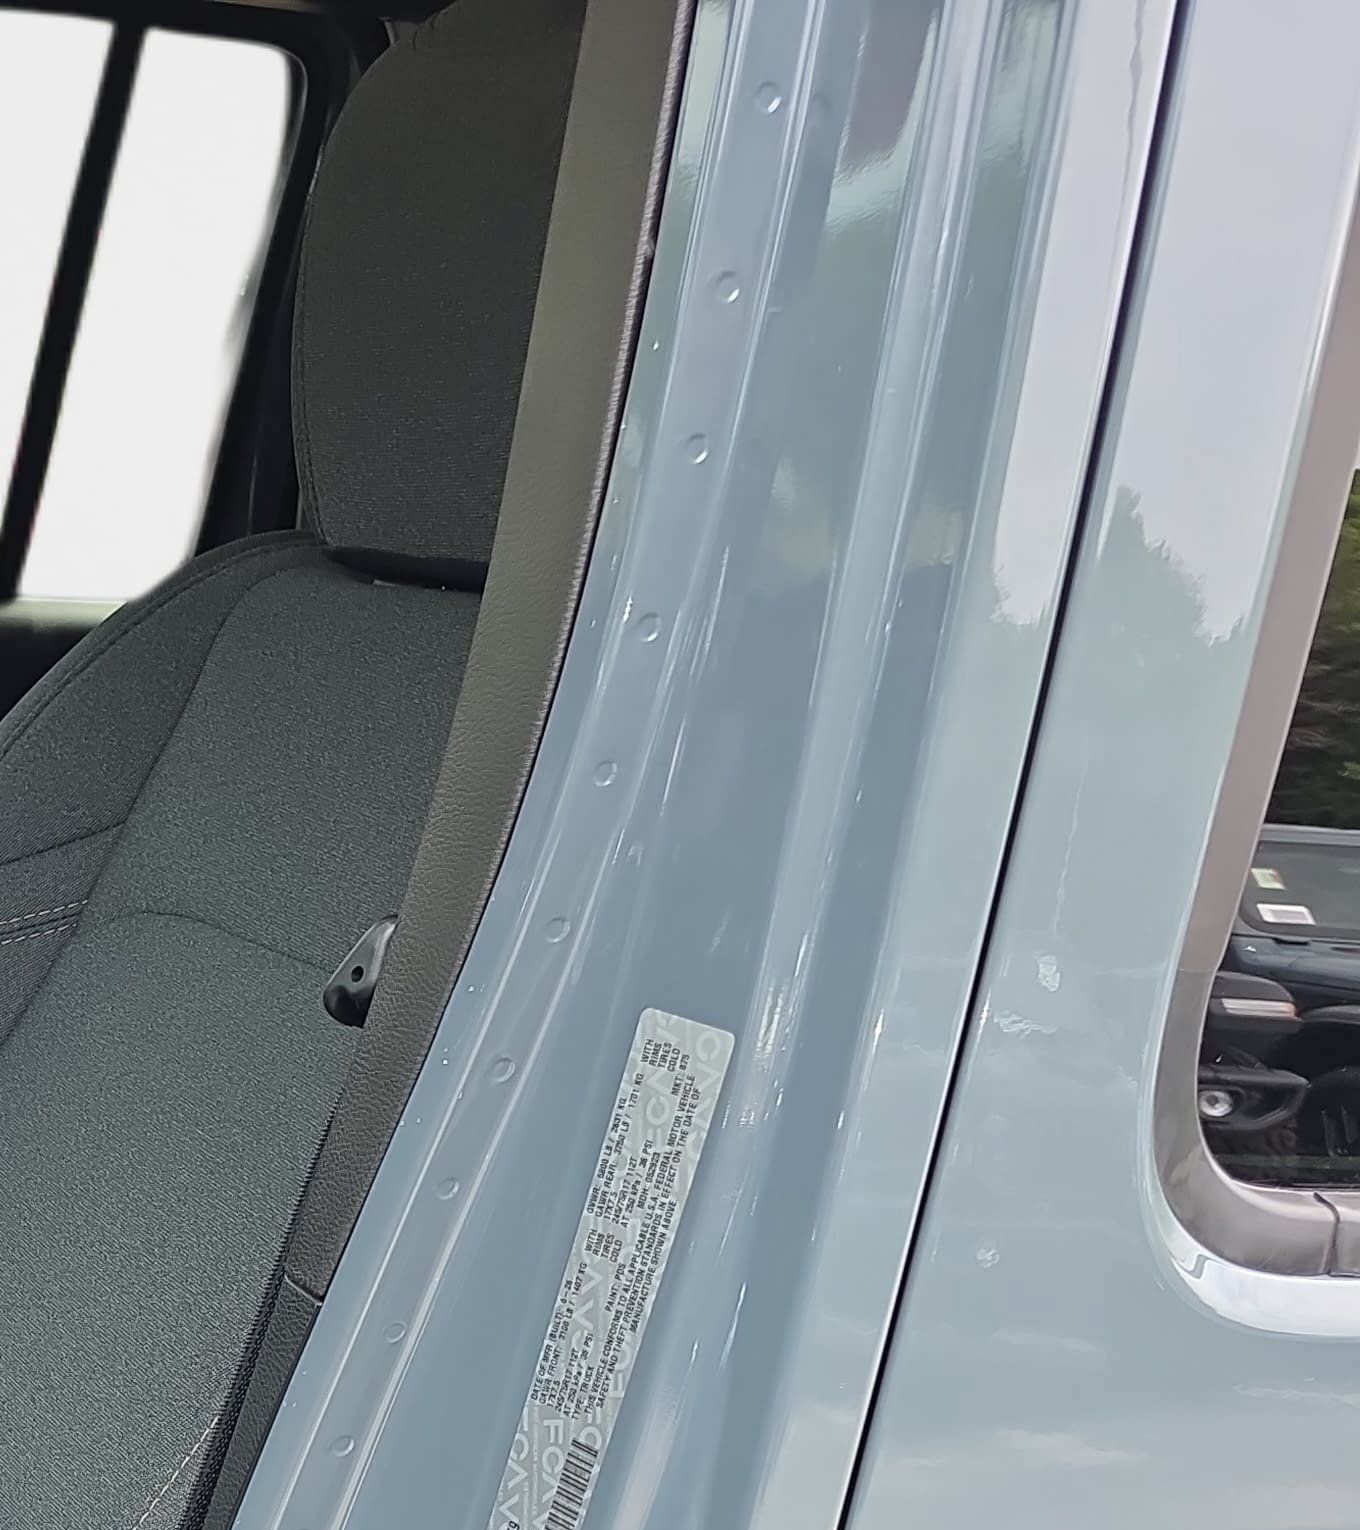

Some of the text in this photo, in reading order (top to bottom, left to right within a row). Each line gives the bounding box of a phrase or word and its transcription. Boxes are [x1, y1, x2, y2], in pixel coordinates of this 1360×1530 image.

[620, 1120, 629, 1132] LB
[634, 1073, 644, 1085] KG
[640, 1038, 654, 1062] WITH
[648, 1042, 661, 1066] RIMS
[657, 1042, 671, 1067] TIRES
[603, 1144, 612, 1156] LB
[620, 1214, 629, 1228] AT
[642, 1139, 653, 1155] PSI
[667, 1048, 680, 1072] COLD
[564, 1307, 573, 1319] LB
[571, 1275, 582, 1295] 1407
[578, 1262, 587, 1274] KG
[584, 1228, 597, 1251] WITH
[583, 1394, 596, 1413] THIS
[591, 1358, 607, 1392] VEHICLE
[602, 1309, 622, 1356] CONFORMS
[617, 1295, 627, 1307] TO
[622, 1278, 633, 1293] ALL
[628, 1222, 650, 1275] APPLICABLE
[653, 1150, 672, 1190] FEDERAL
[666, 1115, 683, 1147] MOTOR
[677, 1075, 695, 1111] VEHICLE
[592, 1233, 604, 1255] RIMS
[596, 1087, 700, 1408] SAFETY AND THEFT PREVENTION STANDARDS IN EFFECT ON THE DATE OF
[600, 1233, 614, 1258] TIRES
[629, 1267, 656, 1332] MANUFACTURE
[650, 1232, 666, 1265] SHOWN
[562, 1403, 571, 1416] AT
[583, 1332, 593, 1347] PSI
[609, 1239, 622, 1262] COLD
[530, 1377, 543, 1400] DATE
[538, 1363, 546, 1376] OF
[542, 1344, 552, 1362] MFR
[579, 1365, 594, 1393] TRUCK
